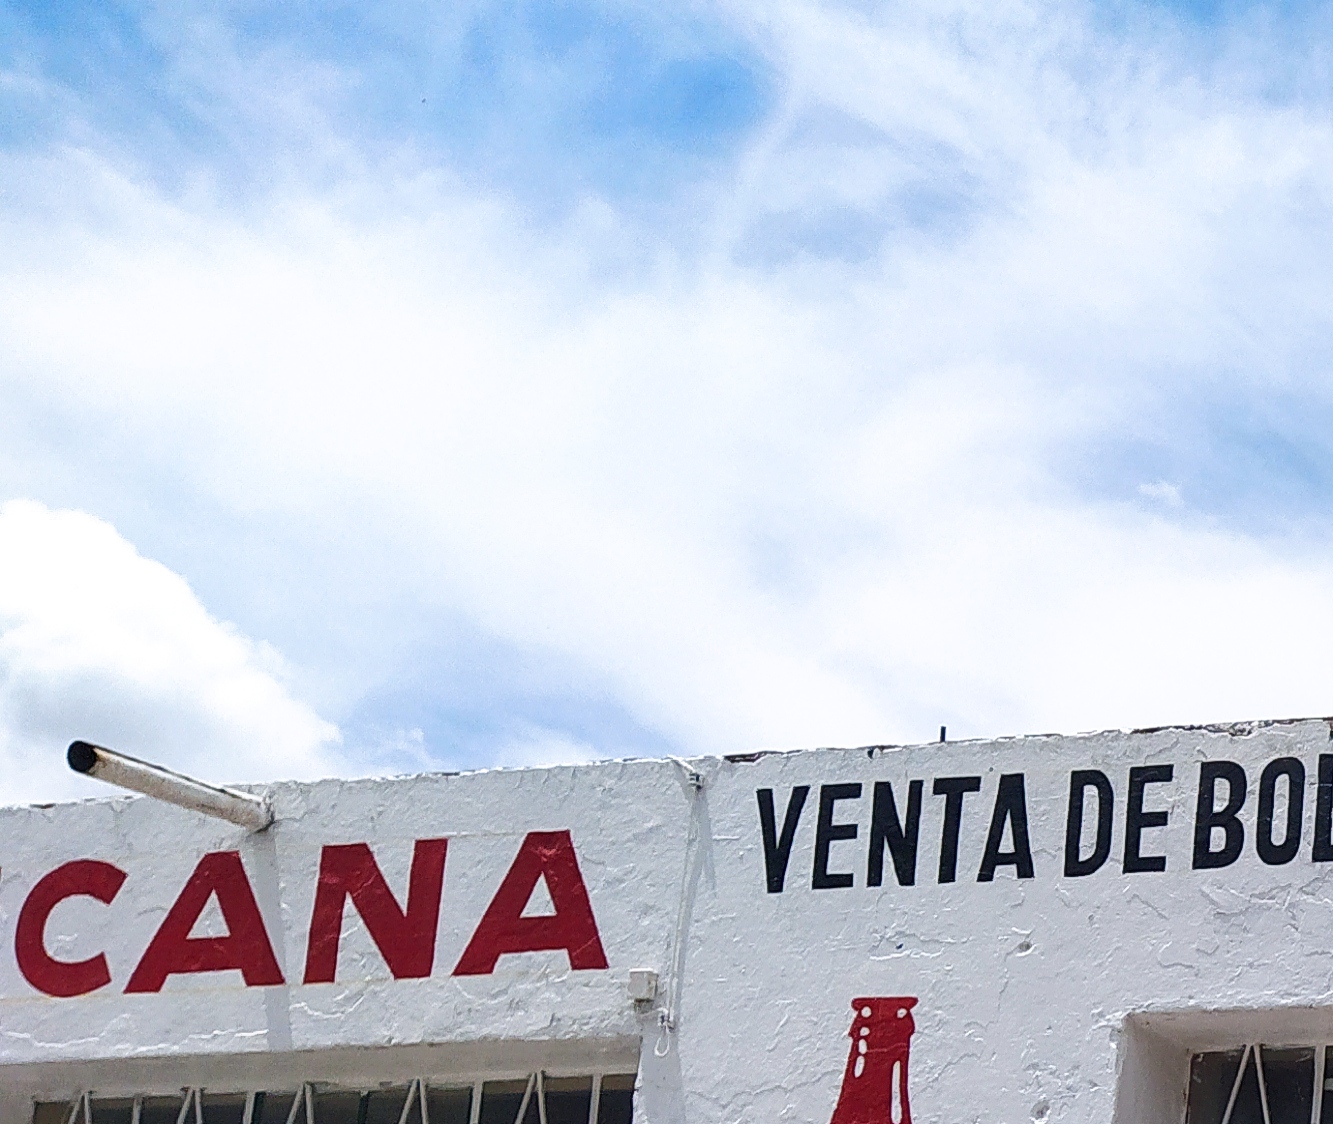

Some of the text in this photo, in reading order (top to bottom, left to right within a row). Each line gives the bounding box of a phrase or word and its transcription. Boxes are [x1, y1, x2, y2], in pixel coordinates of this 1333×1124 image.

[754, 771, 1036, 895] VENTA
[1062, 762, 1176, 879] DE
[0, 830, 606, 998] CANA
